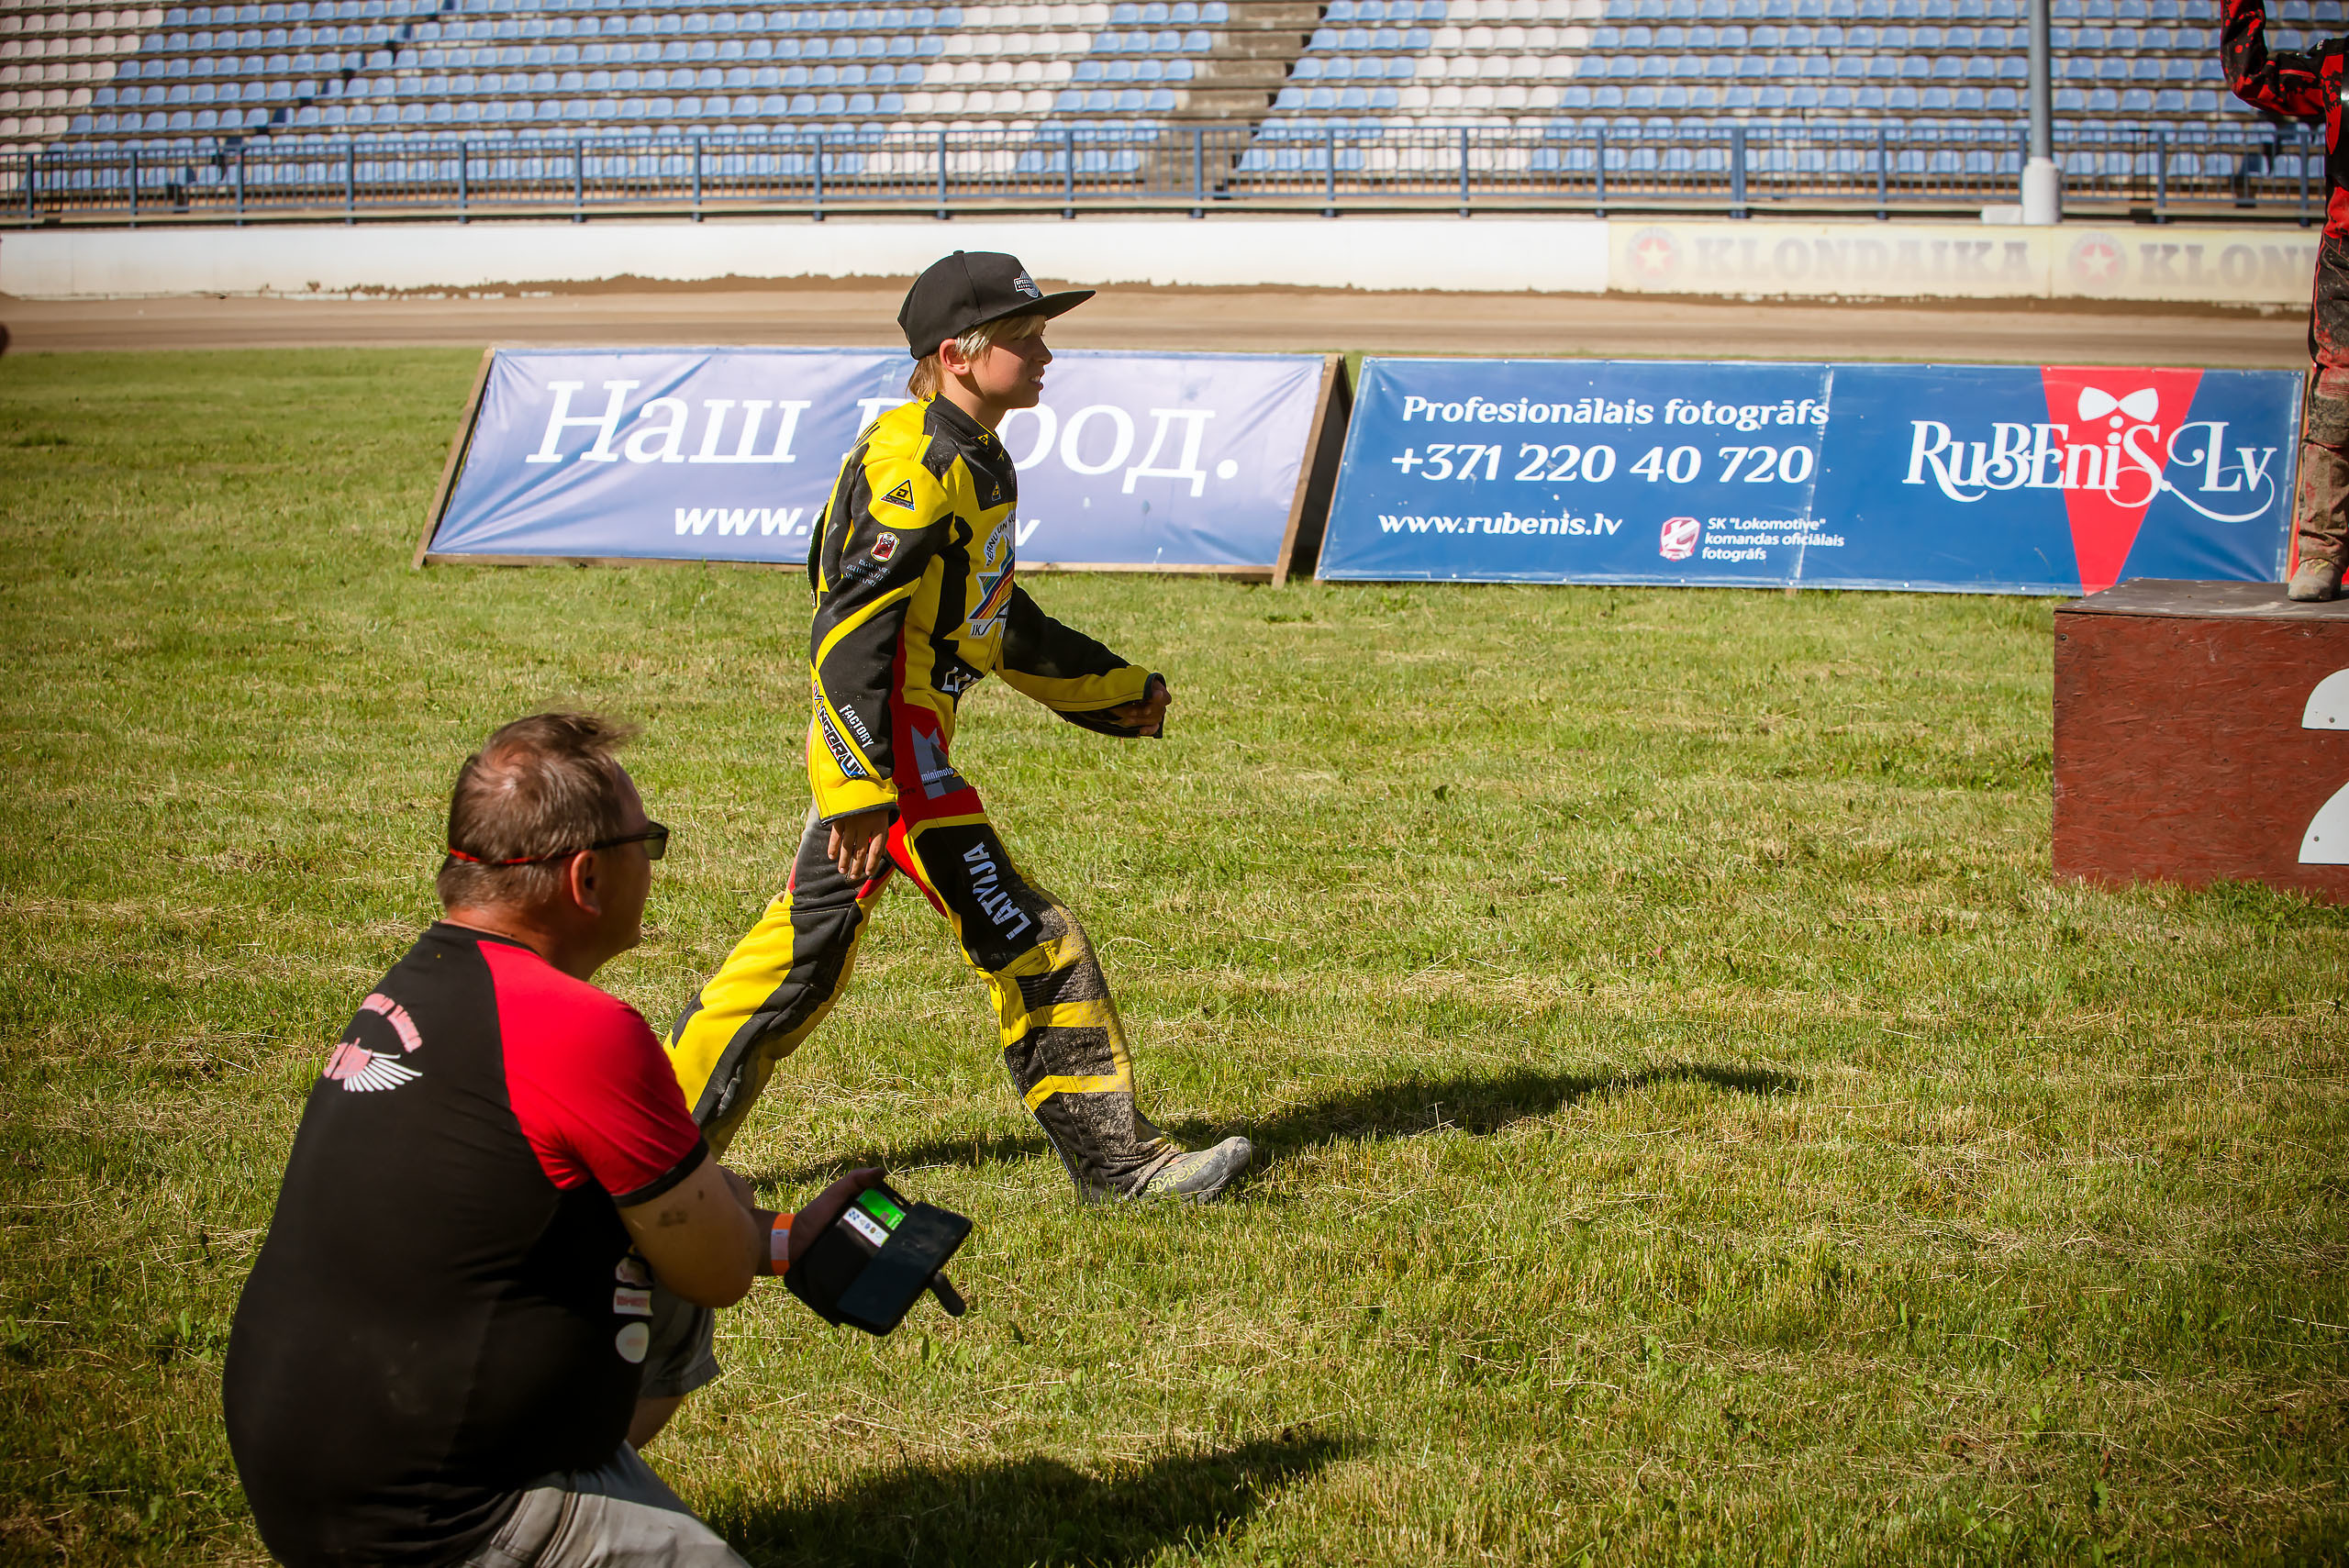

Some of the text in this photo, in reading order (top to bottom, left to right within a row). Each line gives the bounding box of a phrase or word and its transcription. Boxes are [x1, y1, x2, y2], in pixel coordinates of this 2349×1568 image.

[1694, 238, 2033, 282] KLONDAIKA
[2139, 242, 2320, 288] KLON
[525, 379, 812, 464] Наш
[1401, 395, 1830, 432] Profesionālais fotogrāfs
[1391, 442, 1814, 484] +371 220 40 720
[1377, 512, 1623, 537] www.rubenis.lv
[1704, 532, 1845, 548] komandas oficiālais
[1707, 517, 1727, 530] SK
[1701, 547, 1767, 562] fotogrāfs
[839, 704, 874, 749] FACTORY
[921, 767, 954, 782] minimoto
[963, 841, 1031, 940] LATVIJA
